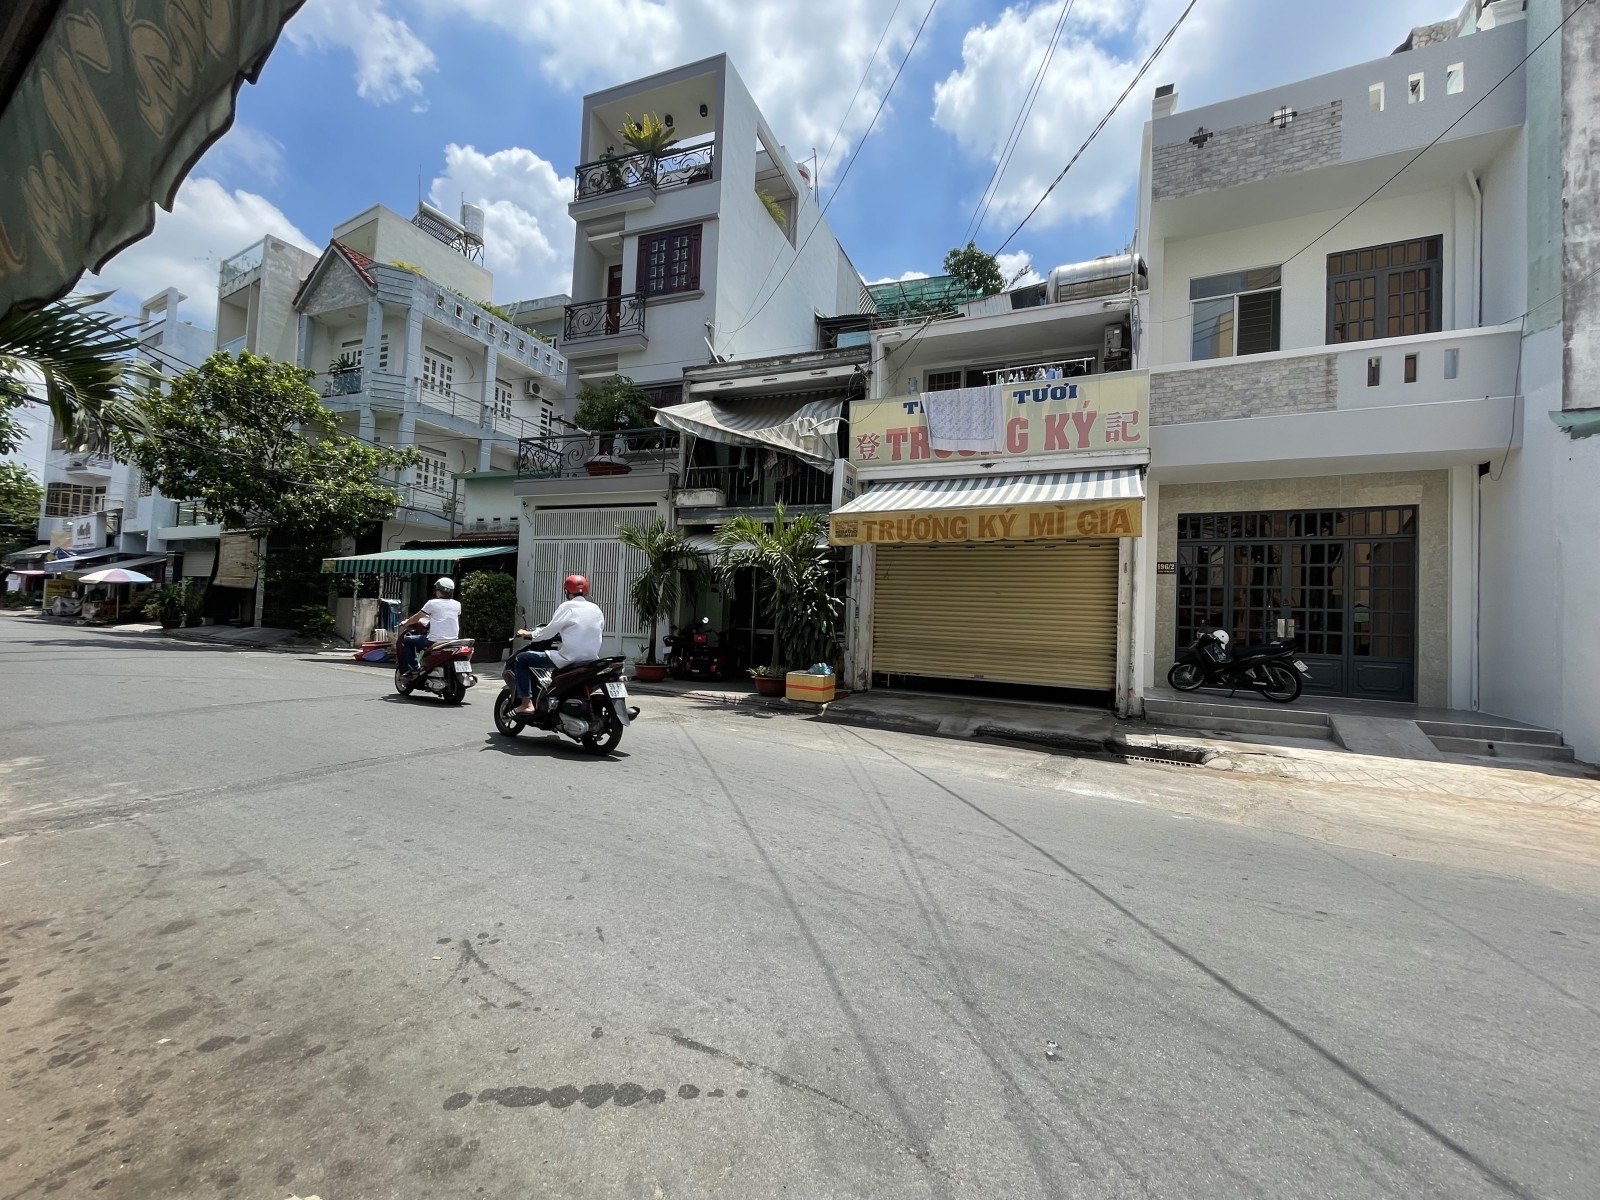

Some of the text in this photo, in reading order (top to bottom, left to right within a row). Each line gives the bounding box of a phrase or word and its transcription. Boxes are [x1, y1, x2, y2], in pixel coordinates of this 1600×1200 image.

[1013, 382, 1078, 404] TƯƠI
[1044, 400, 1098, 451] KÝ
[1105, 410, 1141, 443] 記
[856, 432, 881, 461] 登
[862, 514, 968, 541] TRƯƠNG
[978, 507, 1017, 538] KÝ
[1029, 505, 1065, 537] MÌ
[1077, 508, 1132, 535] GIA
